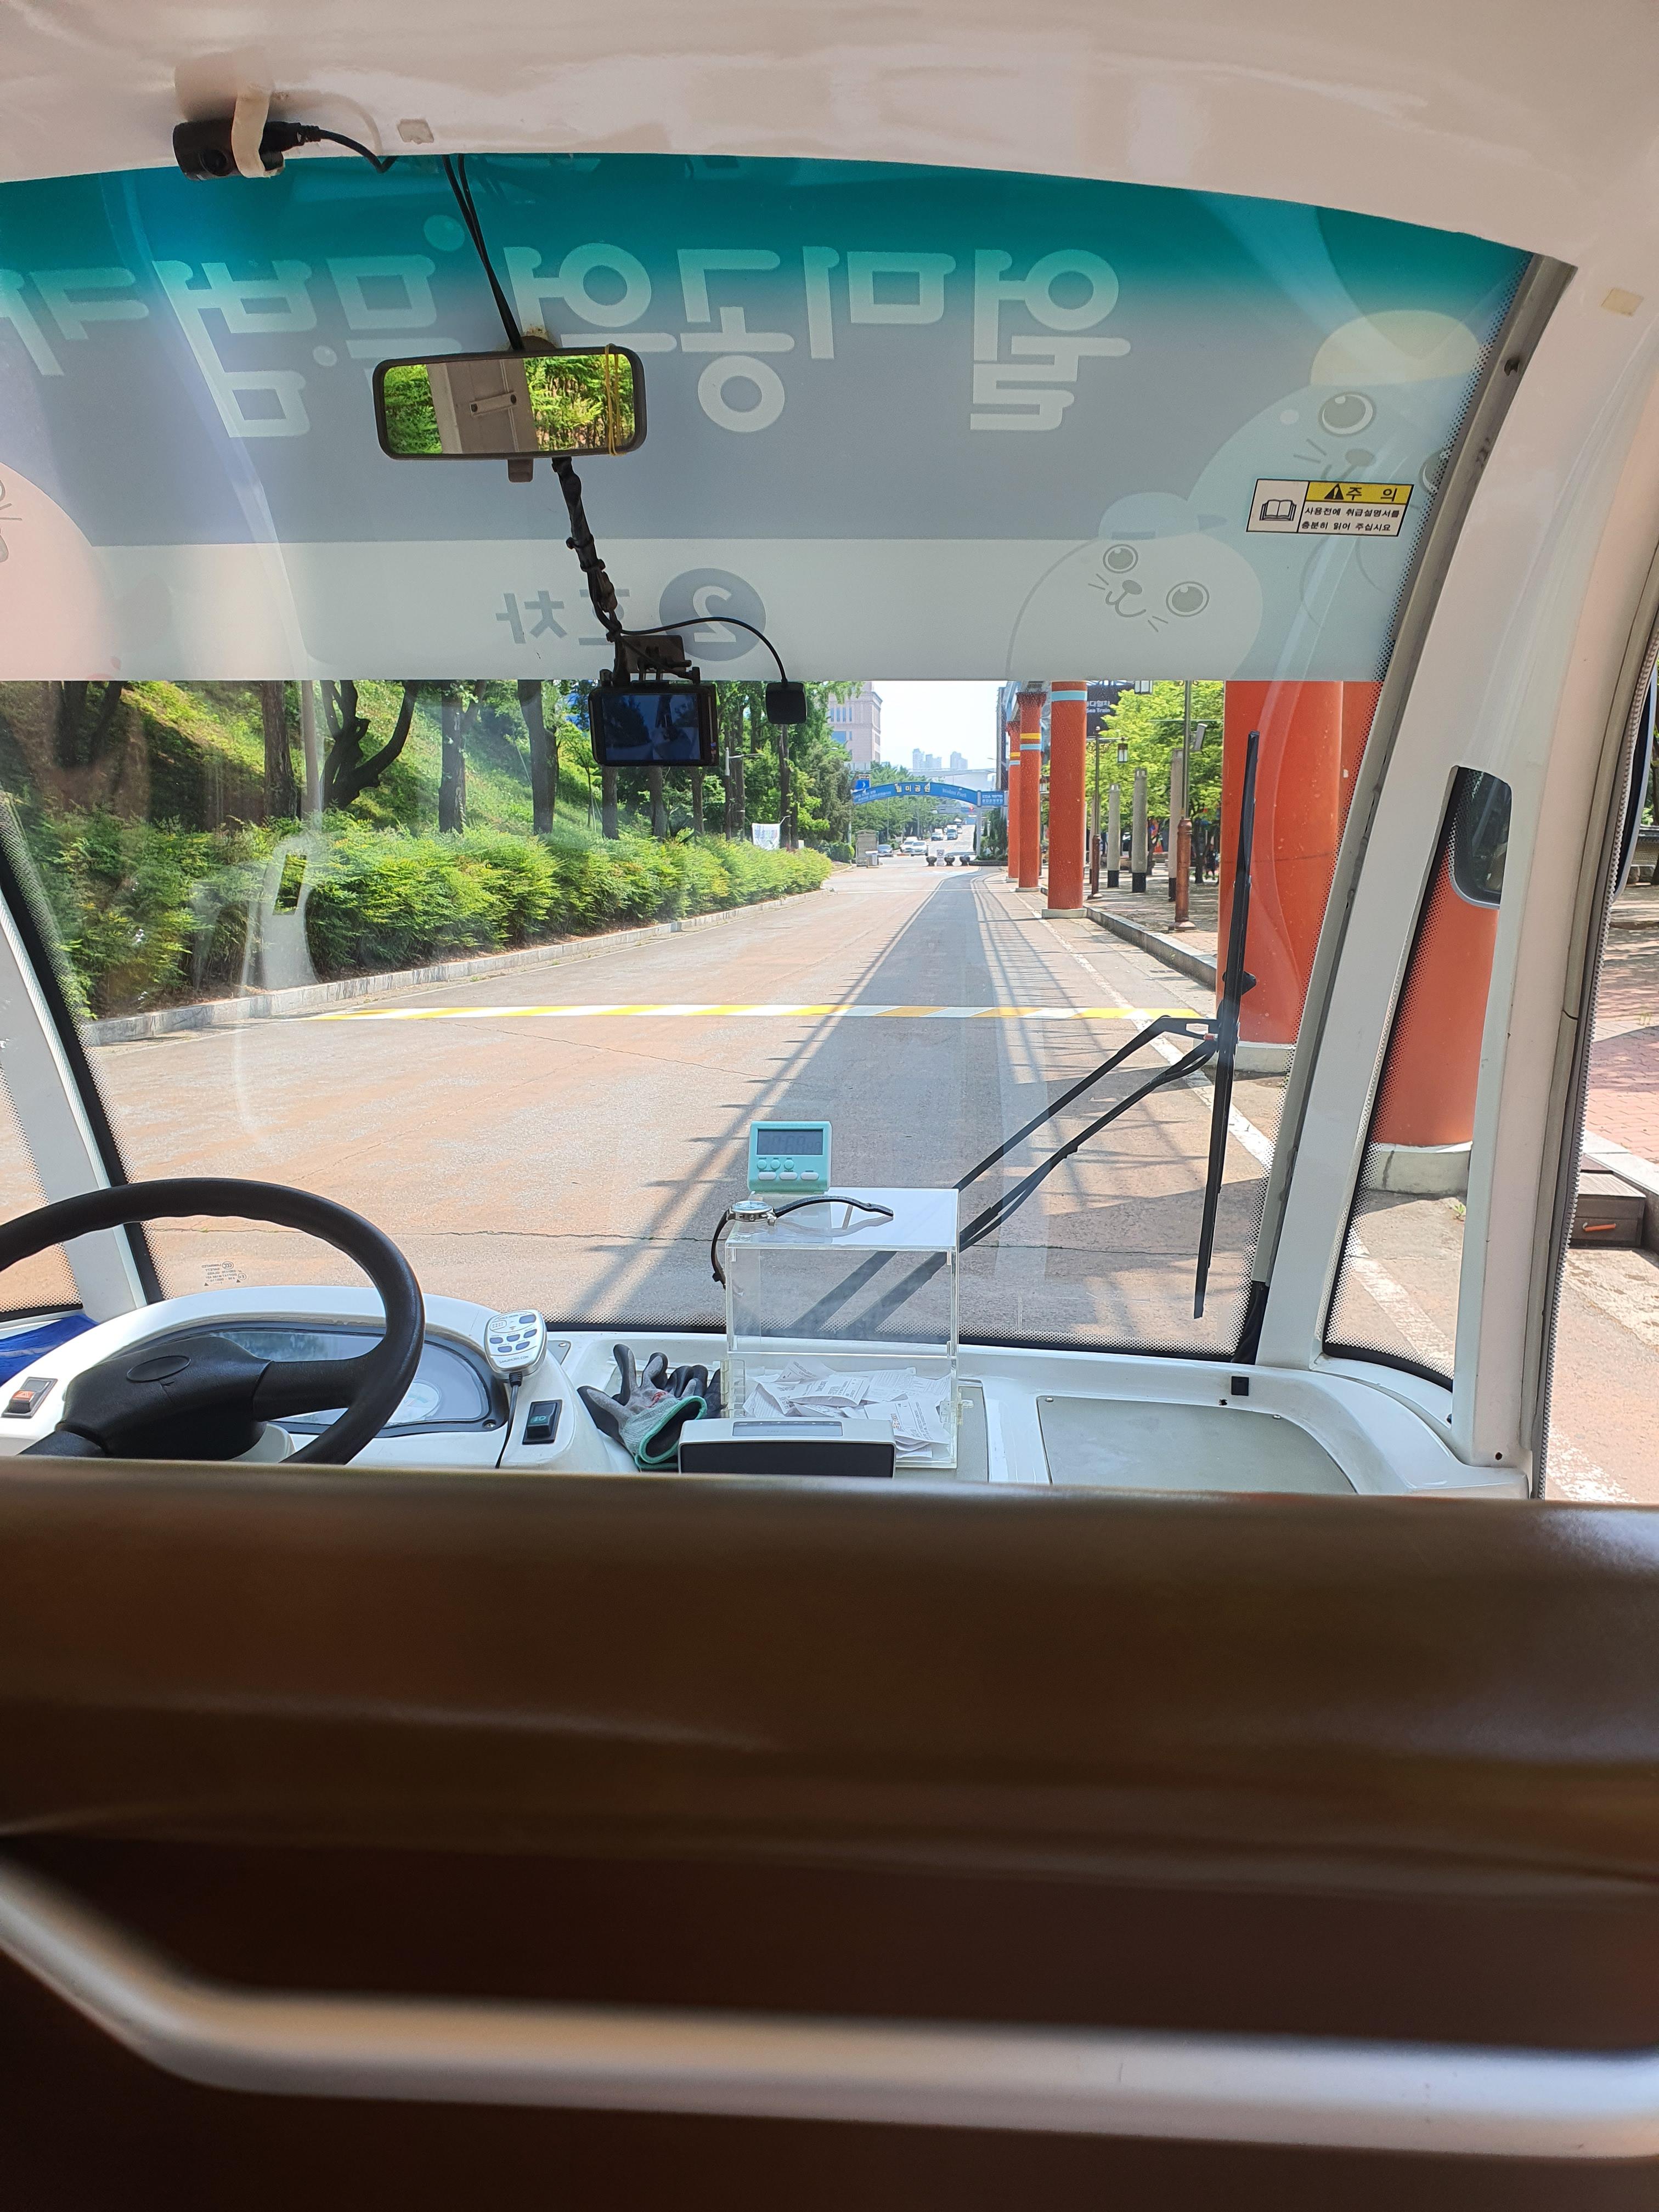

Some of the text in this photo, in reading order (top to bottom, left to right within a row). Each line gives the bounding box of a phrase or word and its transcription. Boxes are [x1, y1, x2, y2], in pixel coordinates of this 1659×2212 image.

[1305, 507, 1400, 518] 사용전에 취급설명서를
[1302, 521, 1328, 529] 충분히
[1356, 523, 1391, 531] 주십시요
[894, 782, 931, 793] 월미공원
